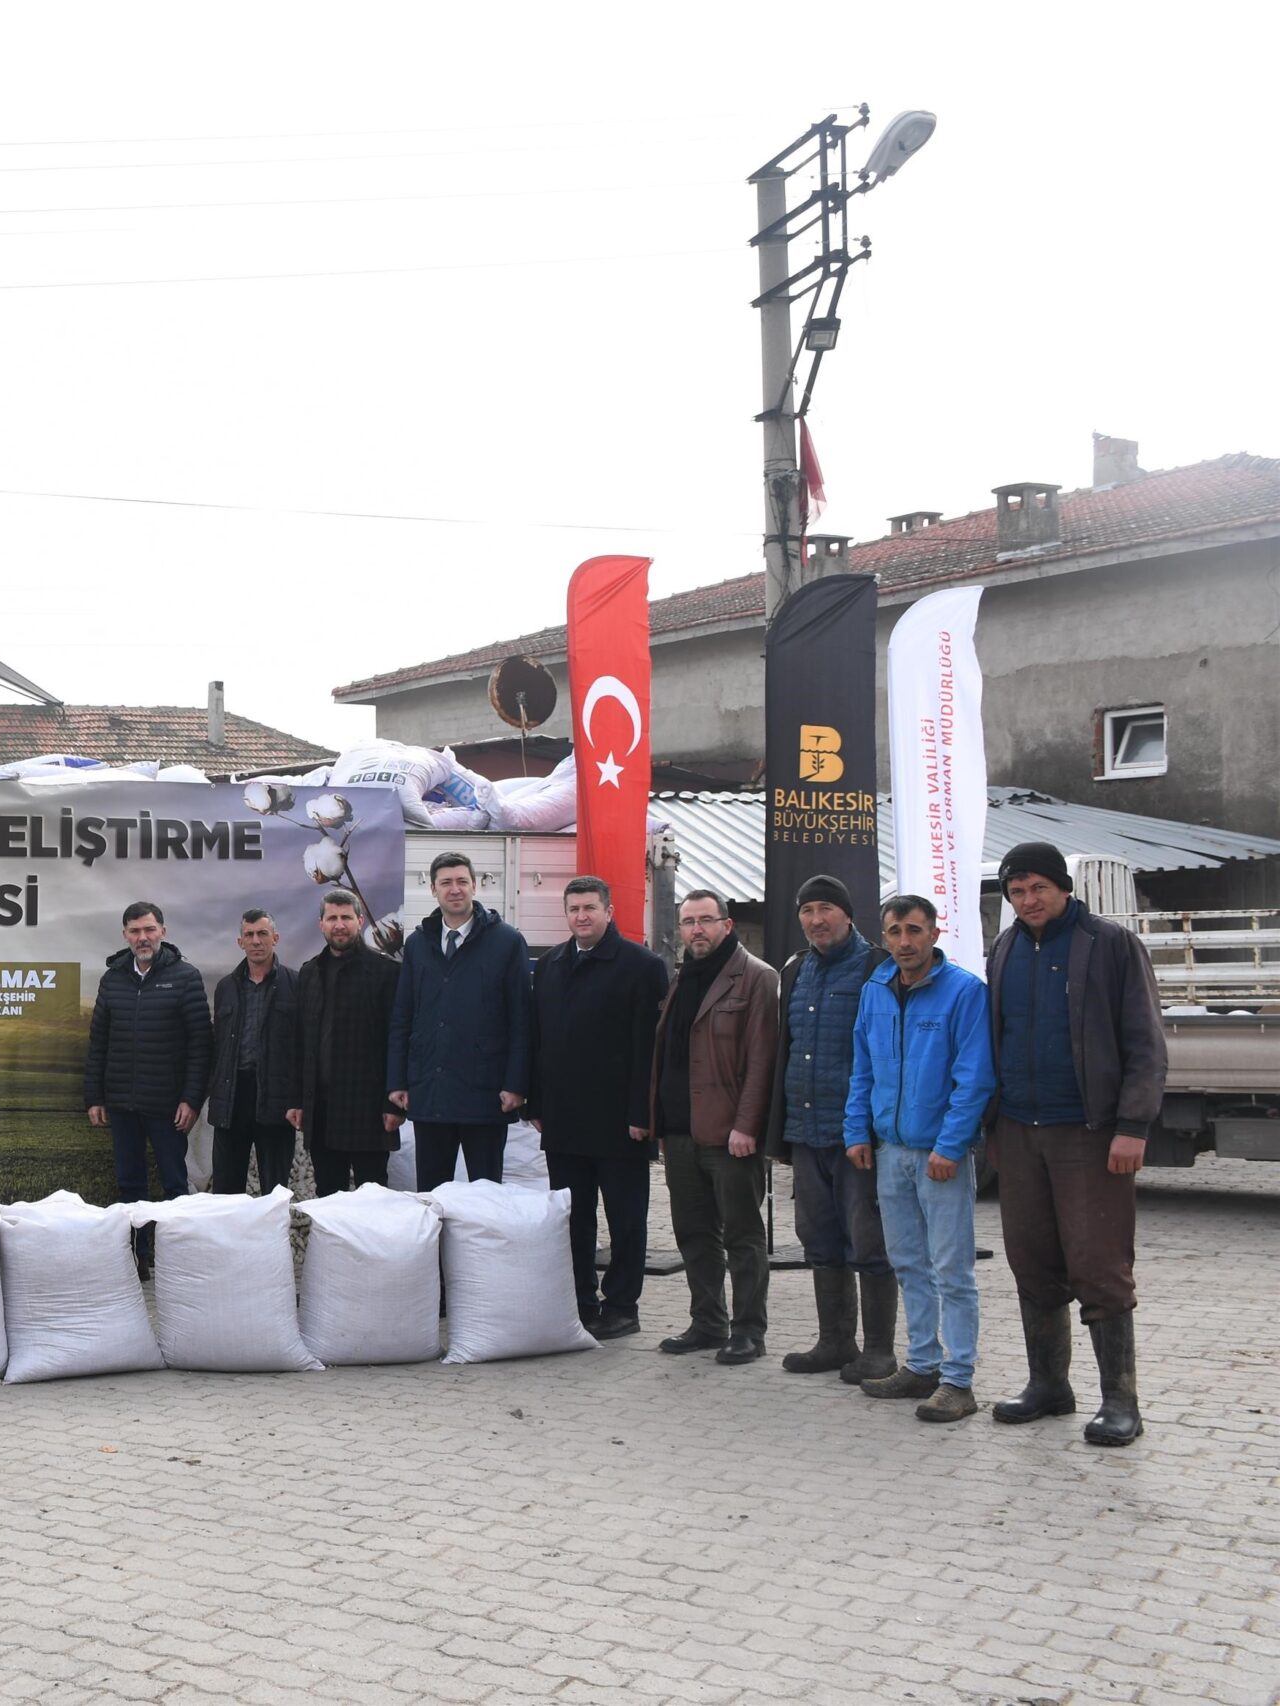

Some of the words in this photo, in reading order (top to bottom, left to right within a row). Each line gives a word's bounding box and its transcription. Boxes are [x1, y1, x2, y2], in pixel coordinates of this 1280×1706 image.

[937, 630, 954, 747] MÜDÜRLÜĞÜ
[920, 718, 940, 795] VALİLİĞİ
[943, 754, 953, 821] ORMAN
[773, 809, 875, 833] BÜYÜKŞEHİR
[774, 788, 875, 813] BALIKESİR
[926, 801, 947, 896] BALIKESİR
